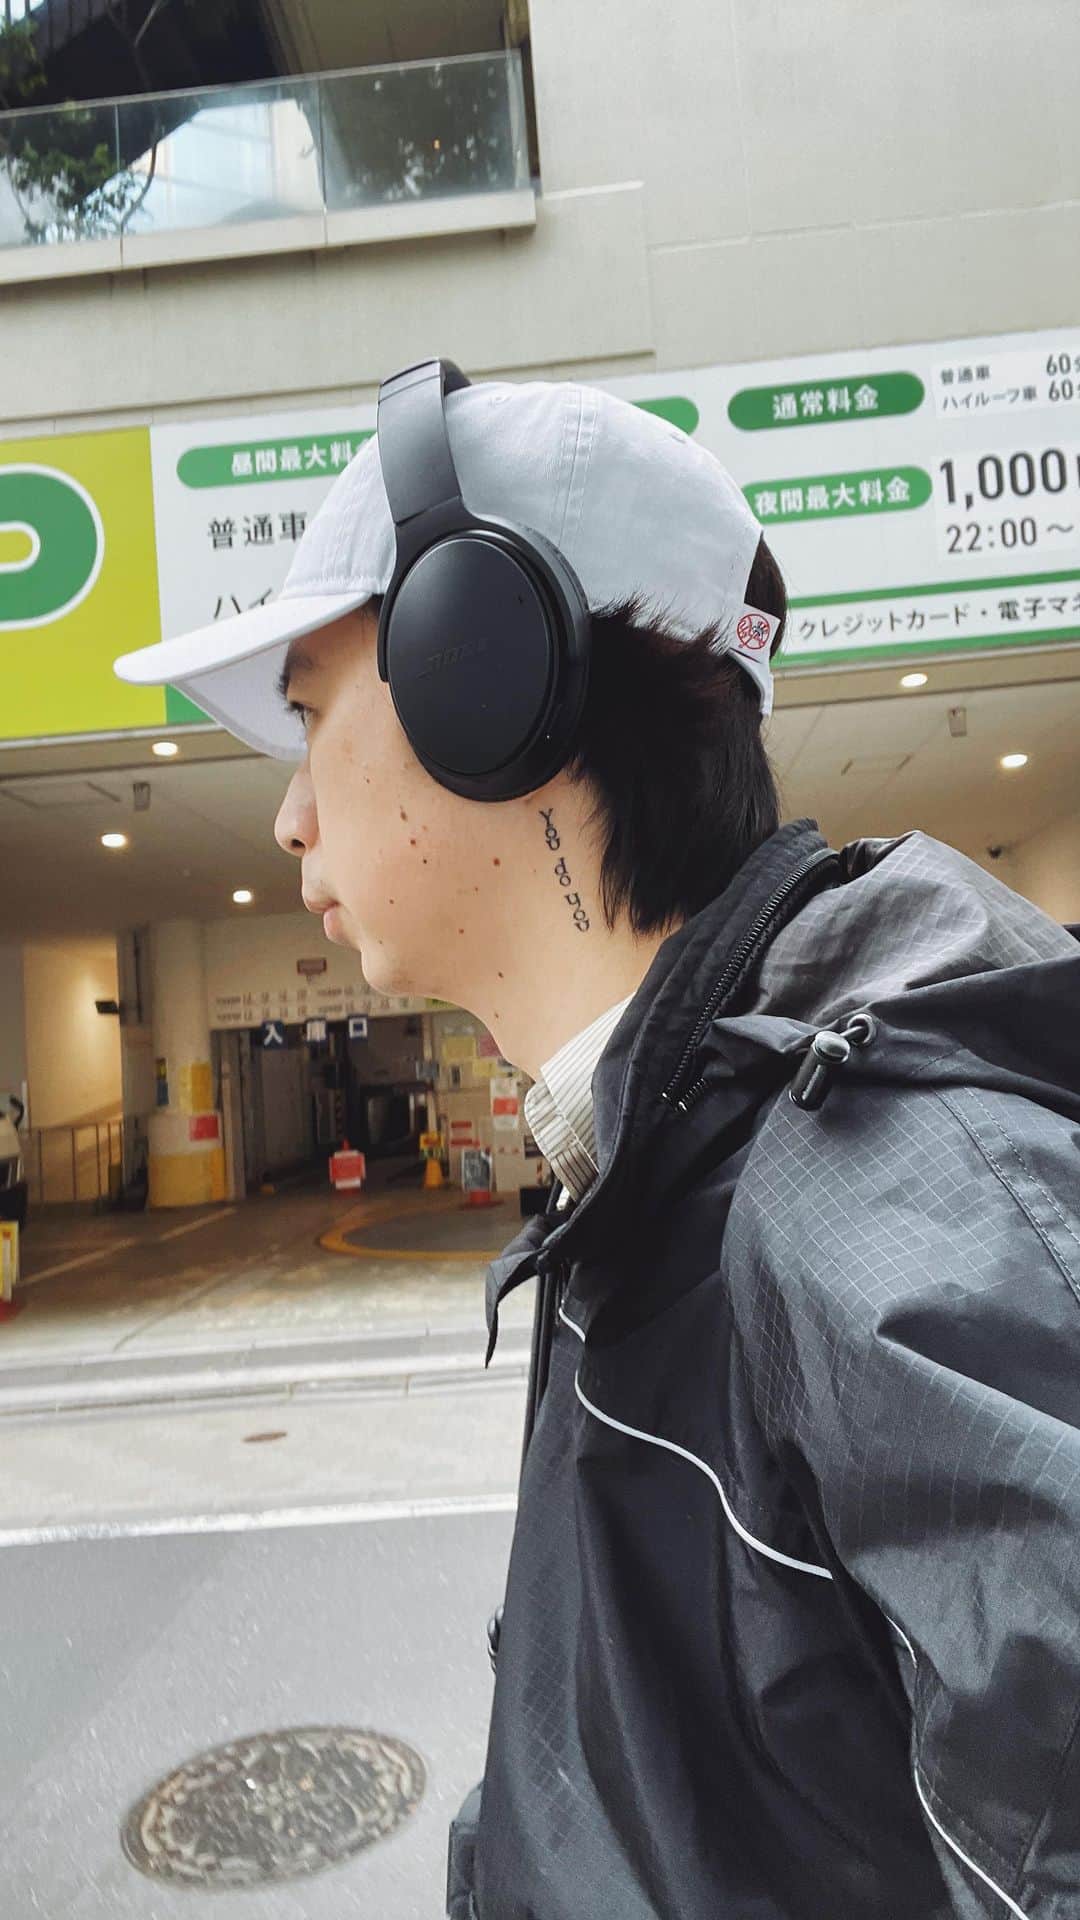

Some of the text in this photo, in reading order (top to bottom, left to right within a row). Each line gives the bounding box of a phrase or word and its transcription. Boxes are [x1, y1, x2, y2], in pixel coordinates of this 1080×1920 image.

[772, 383, 879, 421] 通常料金
[1048, 378, 1080, 402] 60
[754, 475, 910, 517] 夜間最大料金
[939, 447, 1080, 512] 1,000
[207, 509, 307, 550] 普通車
[539, 807, 590, 933] You do you
